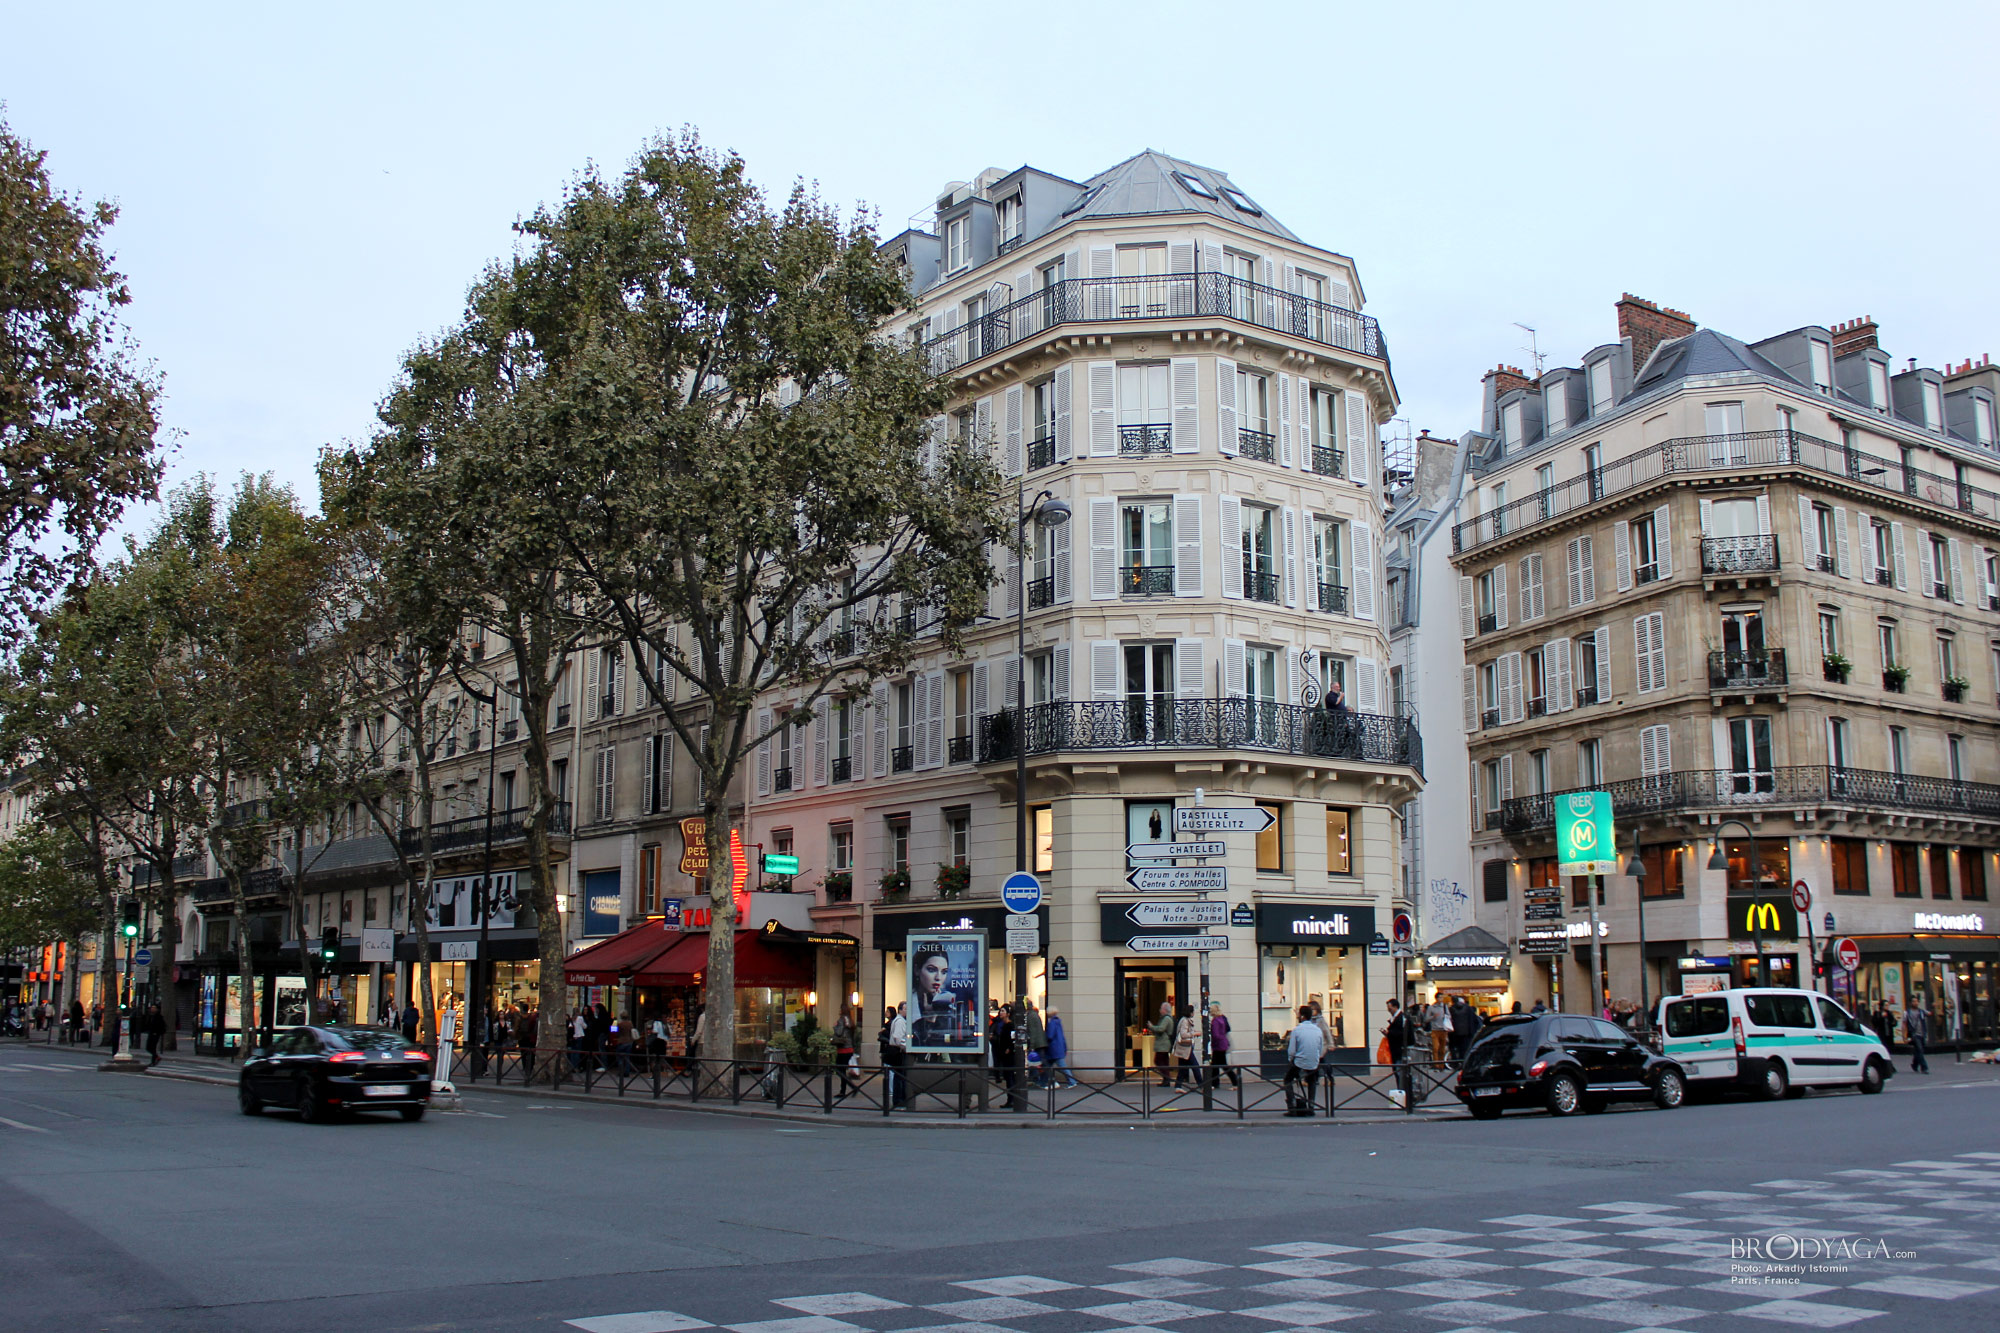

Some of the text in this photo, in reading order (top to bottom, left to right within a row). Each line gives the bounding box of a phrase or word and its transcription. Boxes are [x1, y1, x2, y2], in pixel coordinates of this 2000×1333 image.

[1571, 795, 1592, 807] RER
[1181, 811, 1229, 820] BASTILLE
[686, 823, 708, 834] CA
[1181, 820, 1245, 829] AUSTERLITZ
[1575, 826, 1592, 844] M
[687, 847, 709, 856] PET
[1169, 844, 1220, 854] CHATELET
[1143, 871, 1170, 879] Forum
[1193, 870, 1222, 878] Halles
[1141, 880, 1166, 888] Centre
[1178, 879, 1222, 888] POMPIDOU
[1143, 905, 1170, 913] Palais
[1190, 904, 1222, 913] Justice
[1162, 914, 1188, 922] Notre
[1196, 914, 1222, 922] Dame
[1914, 912, 1984, 931] McDonald's
[1292, 913, 1349, 935] minelli
[941, 944, 974, 952] LAUDER
[1142, 939, 1174, 948] Théâtre
[1427, 956, 1503, 967] SUPERMARKET
[951, 980, 975, 988] ENVY
